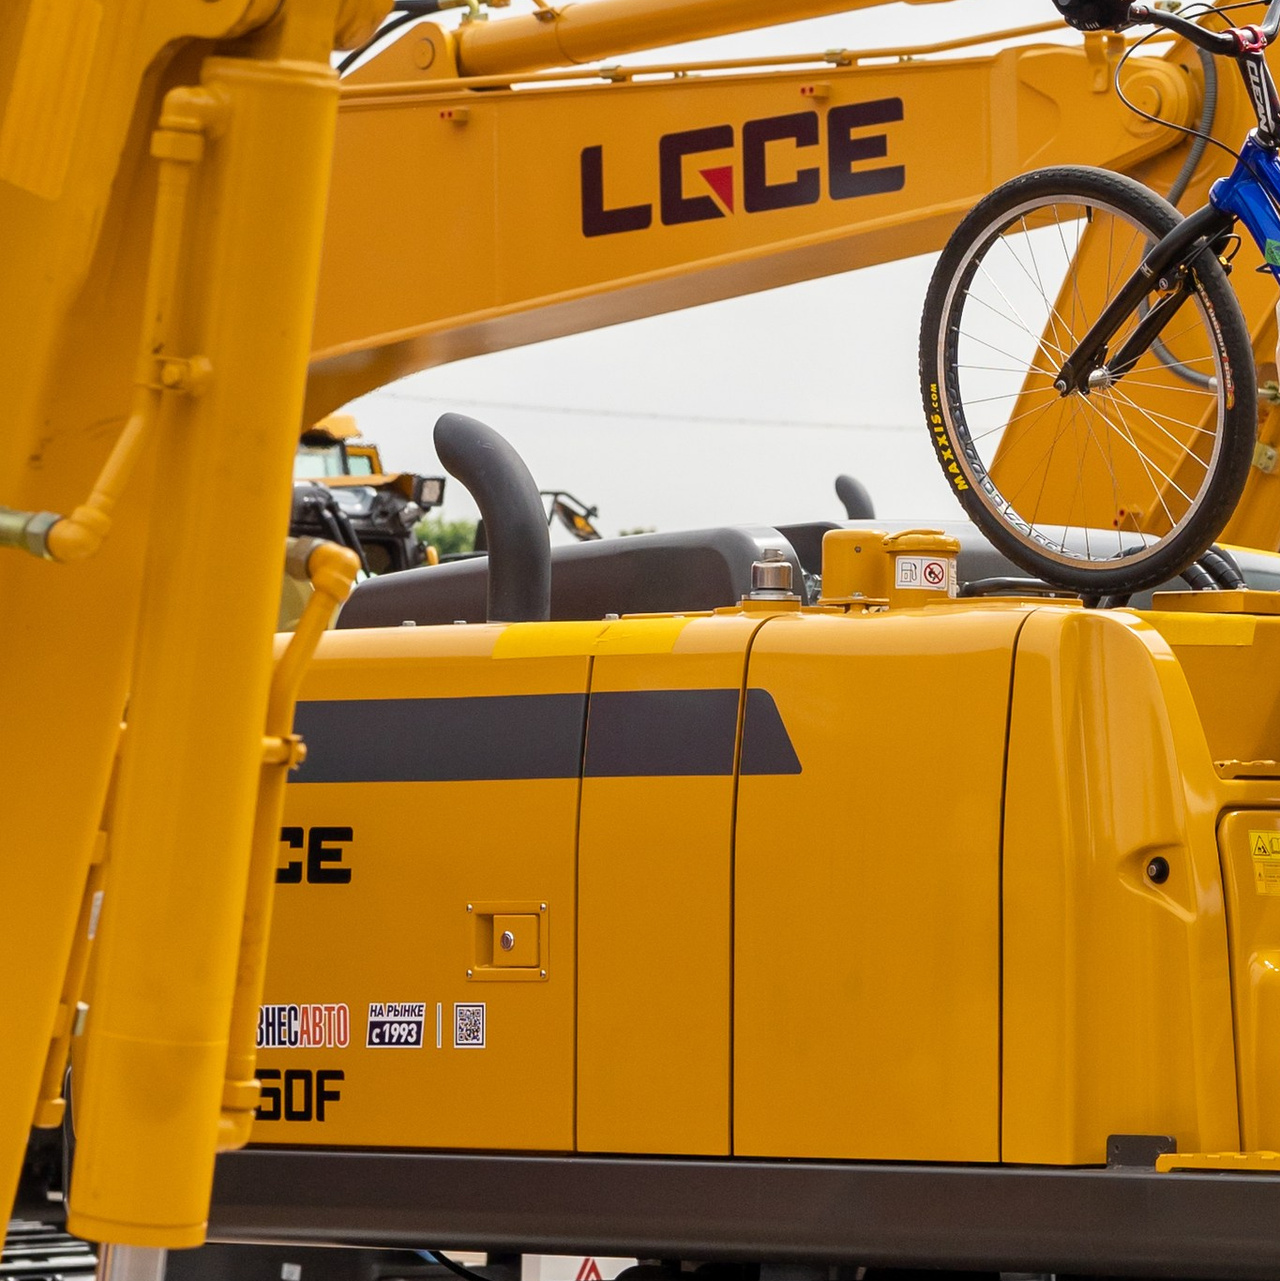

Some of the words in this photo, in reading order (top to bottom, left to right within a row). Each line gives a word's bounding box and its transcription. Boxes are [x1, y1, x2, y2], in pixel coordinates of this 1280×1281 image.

[1246, 60, 1271, 133] CLEAN
[581, 97, 905, 238] LGCE
[370, 1004, 384, 1018] НА
[387, 1004, 424, 1018] РЫНКЕ
[382, 1022, 418, 1043] 1993
